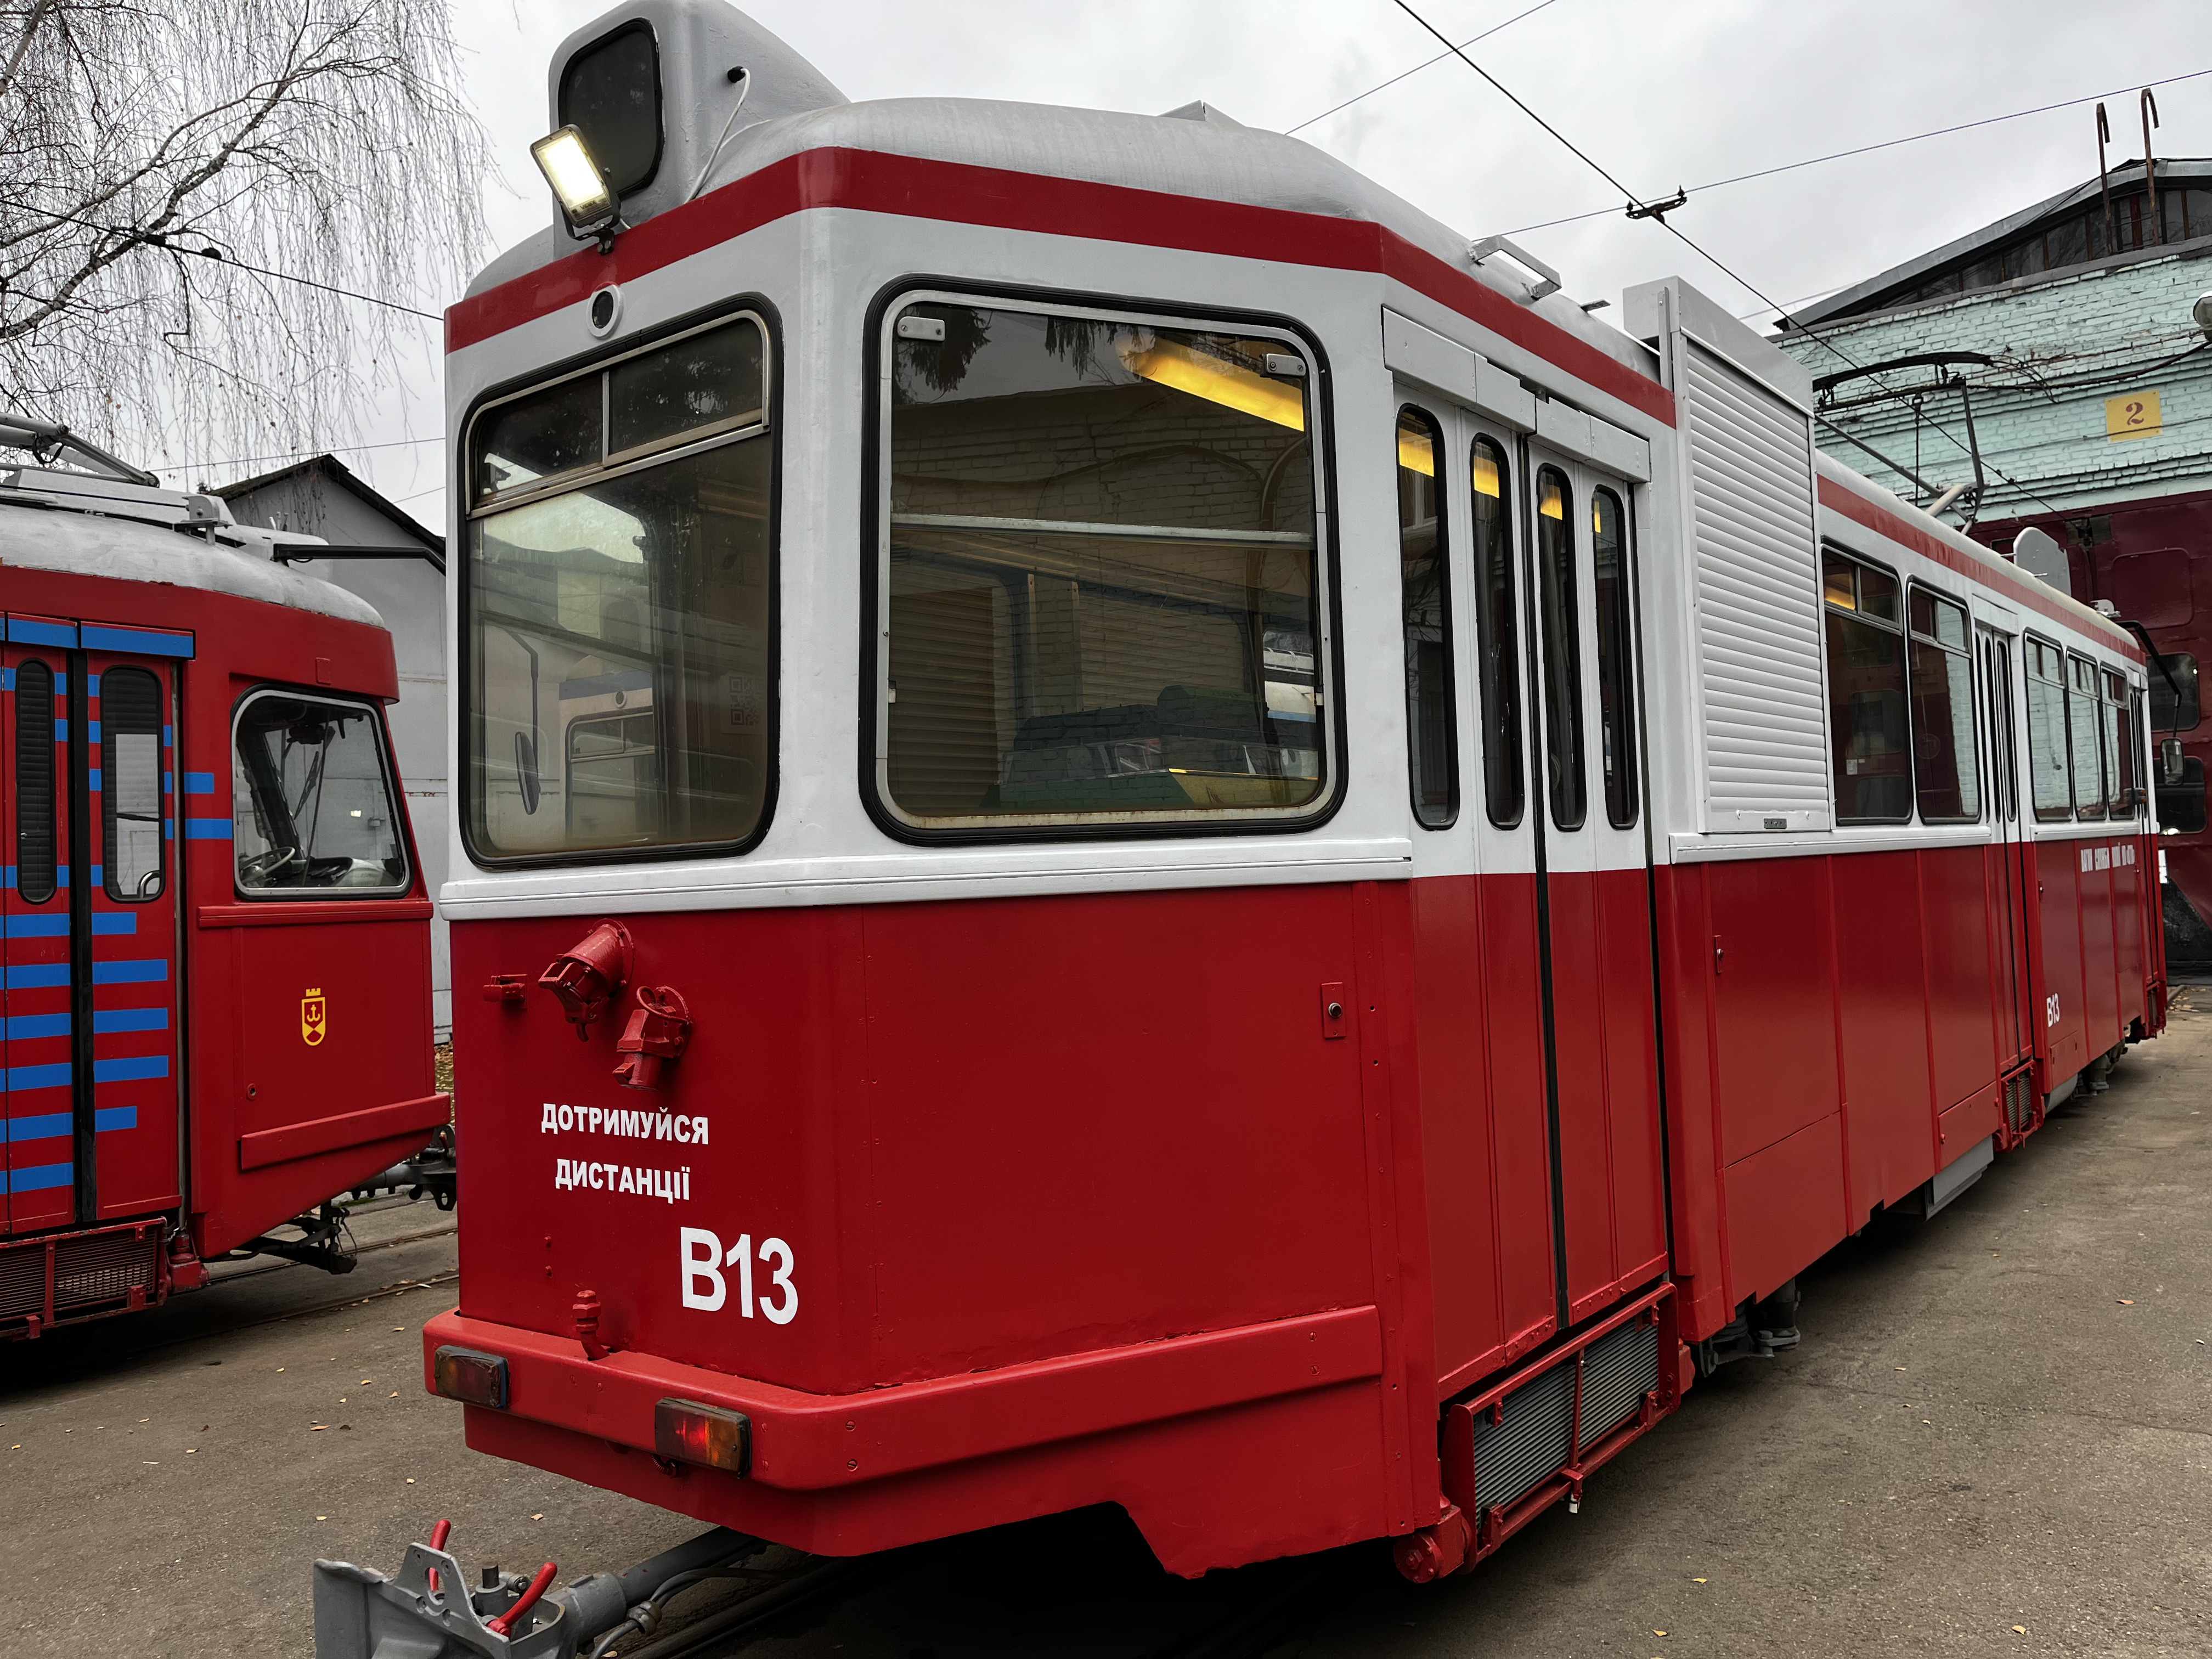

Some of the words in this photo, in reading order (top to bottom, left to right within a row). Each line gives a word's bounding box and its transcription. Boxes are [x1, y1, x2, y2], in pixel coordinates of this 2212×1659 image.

[2125, 402, 2145, 425] 2
[541, 1103, 709, 1145] ДОТРИМУЙСЯ
[555, 1158, 690, 1204] ДИСТАНЦІЇ
